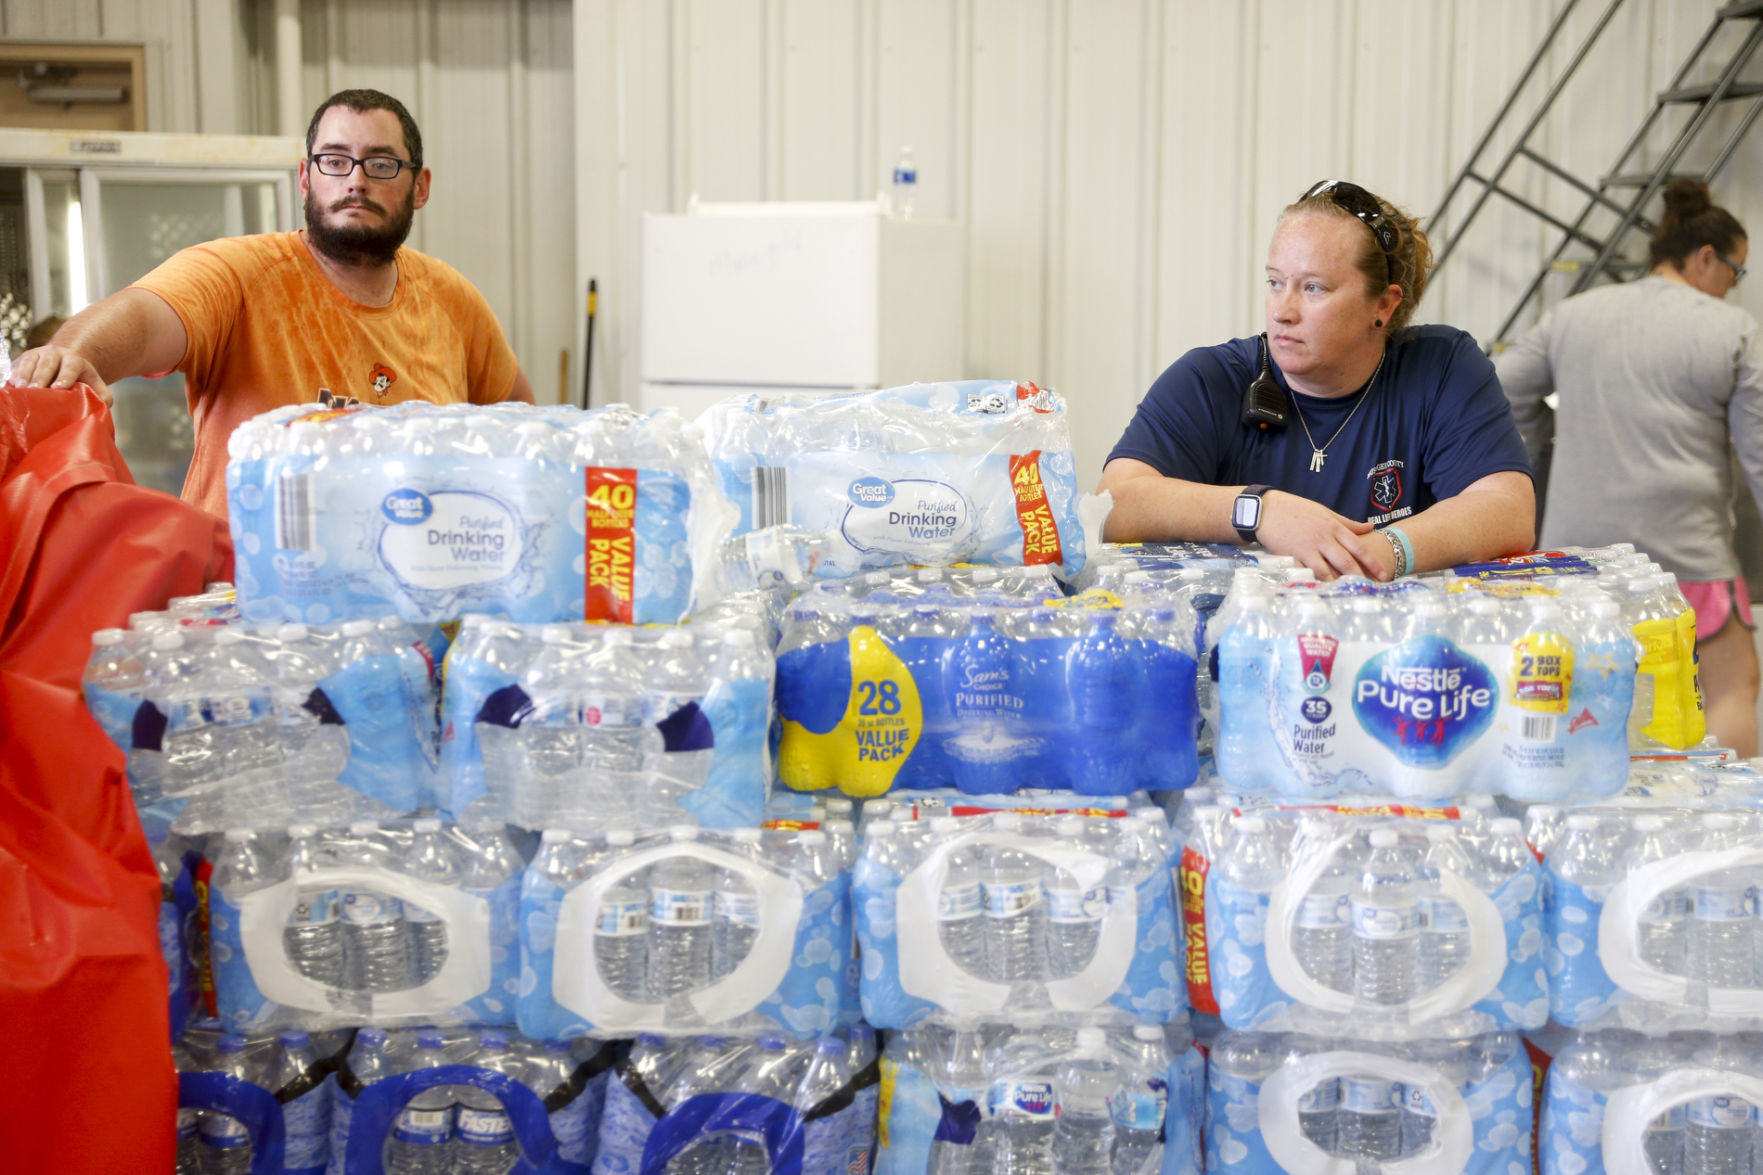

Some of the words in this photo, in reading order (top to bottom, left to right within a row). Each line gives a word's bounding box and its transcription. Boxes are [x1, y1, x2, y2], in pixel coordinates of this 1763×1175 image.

[1014, 463, 1039, 485] 40
[588, 484, 634, 510] 40
[852, 483, 888, 495] Great
[860, 493, 888, 502] Value
[385, 496, 423, 510] Great
[917, 500, 956, 513] Purified
[460, 515, 504, 531] Purified
[888, 512, 957, 528] Drinking
[1035, 504, 1058, 554] VALUE
[427, 530, 504, 550] Drinking
[909, 526, 956, 539] Water
[1021, 511, 1040, 555] PACK
[450, 547, 505, 562] Water
[589, 539, 610, 589] PACK
[611, 536, 632, 602] VALUE
[1520, 655, 1535, 677] 2
[1537, 655, 1561, 666] BOX
[960, 664, 1009, 688] Sam's
[1381, 665, 1462, 692] Nestlé
[1537, 666, 1561, 677] TOPS
[973, 683, 1004, 691] CHOICE
[857, 680, 902, 715] 28
[955, 692, 1024, 709] PURIFIED
[1357, 679, 1434, 720] Pure
[1440, 685, 1491, 721] Life
[1305, 700, 1328, 714] 35
[855, 728, 910, 747] VALUE
[1294, 723, 1337, 740] Purified
[858, 742, 905, 762] PACK
[1293, 739, 1326, 754] Water
[1191, 923, 1208, 985] VALUE
